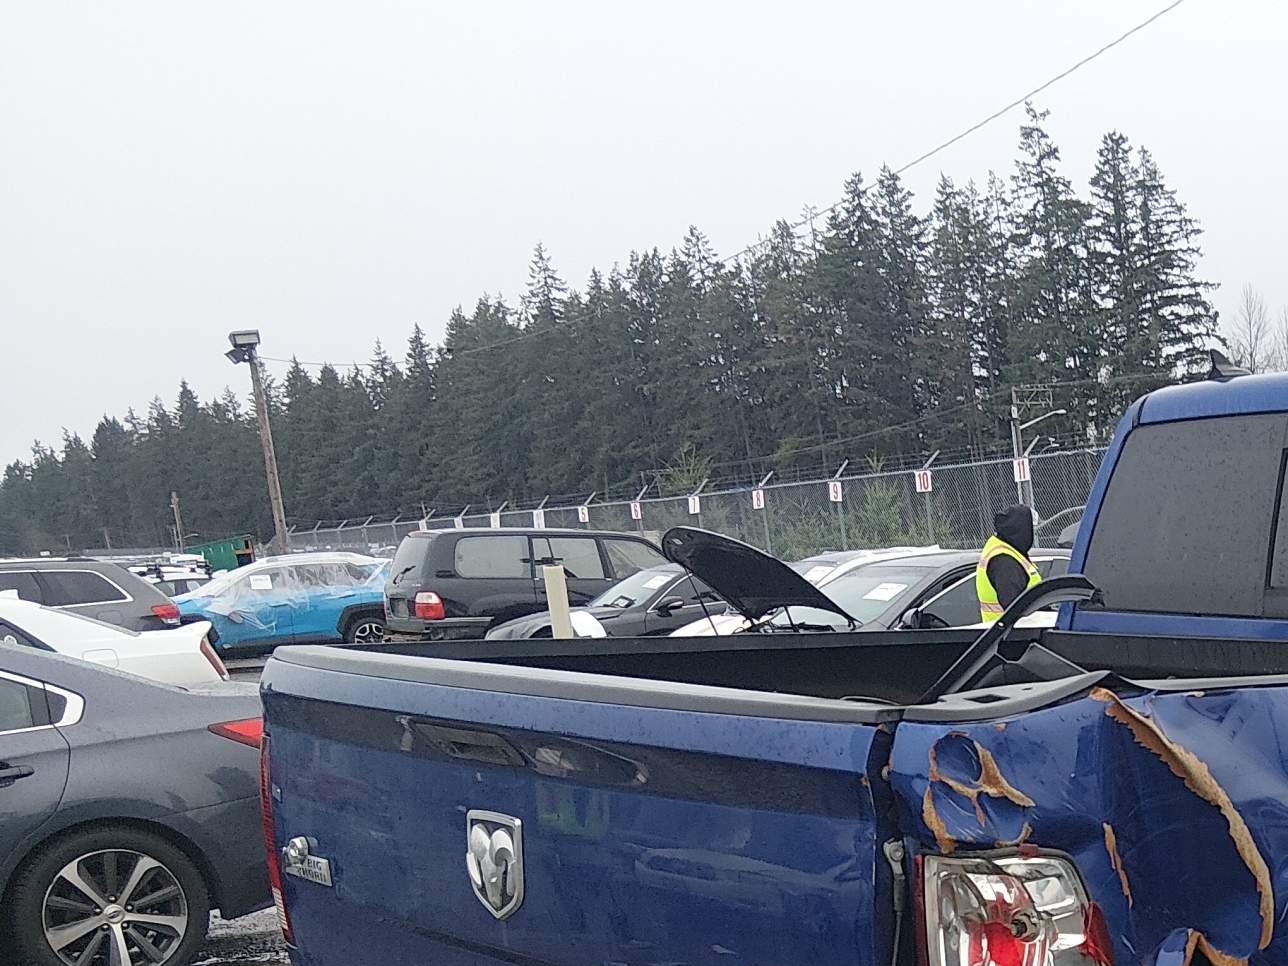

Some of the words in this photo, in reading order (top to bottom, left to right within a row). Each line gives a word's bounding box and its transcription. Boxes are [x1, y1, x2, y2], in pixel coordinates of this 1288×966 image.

[1017, 460, 1026, 480] 11
[917, 471, 929, 490] 10
[755, 491, 761, 507] 8
[832, 483, 839, 500] 9
[633, 503, 640, 519] 6
[691, 497, 697, 513] 7
[580, 507, 587, 521] 5
[307, 858, 322, 871] BIG
